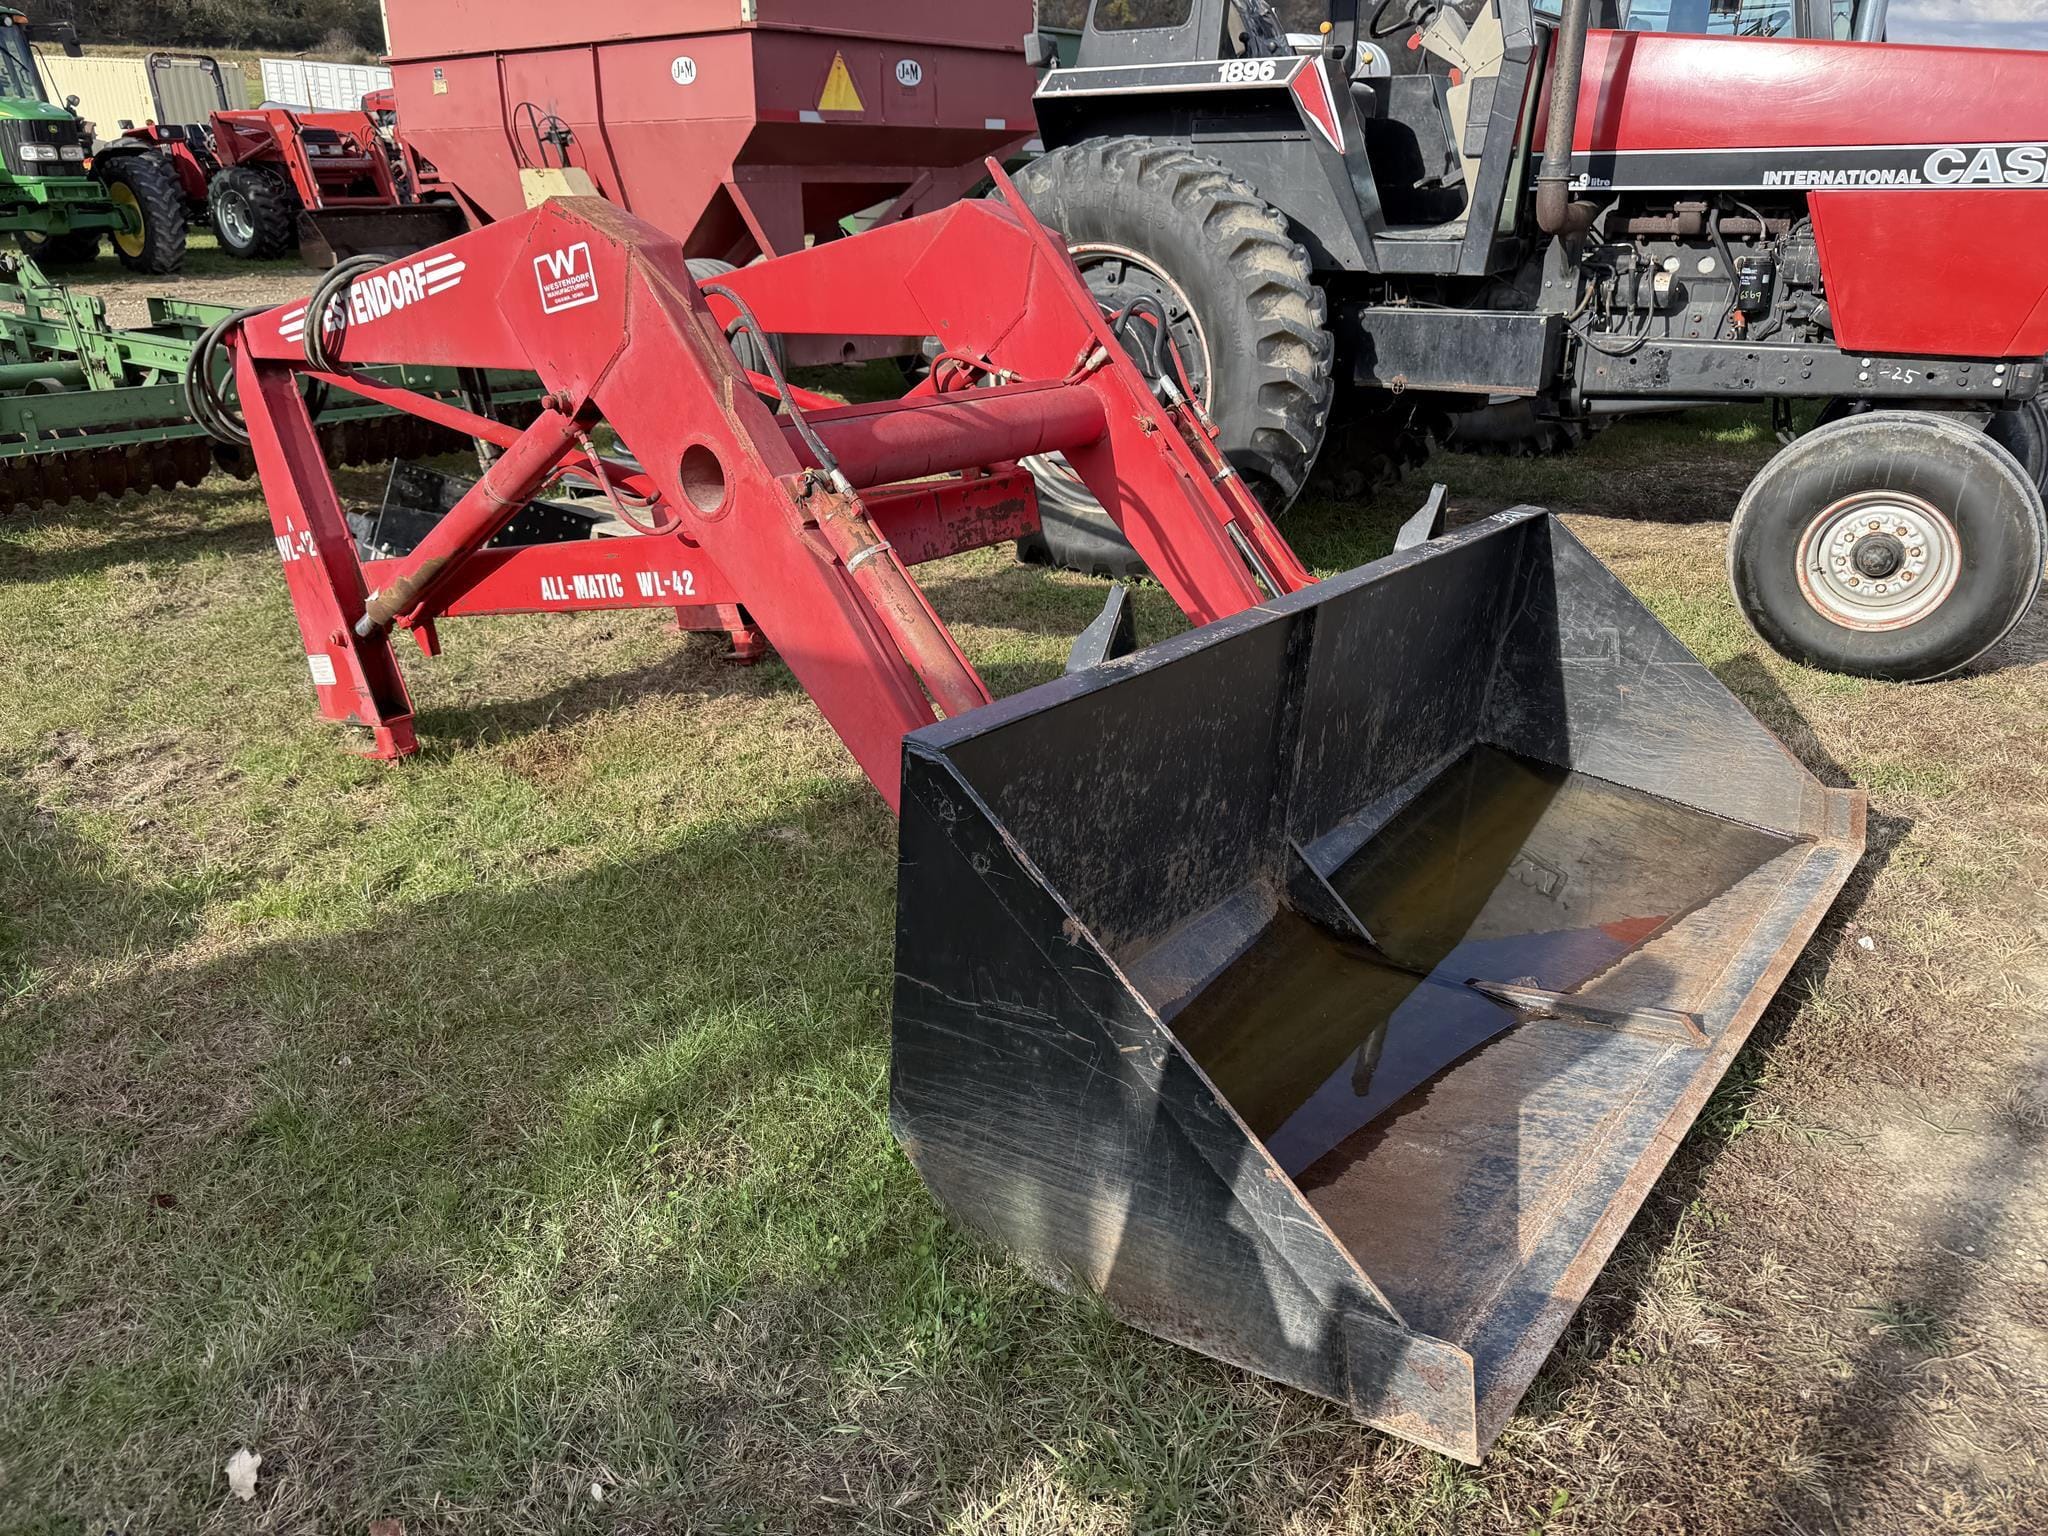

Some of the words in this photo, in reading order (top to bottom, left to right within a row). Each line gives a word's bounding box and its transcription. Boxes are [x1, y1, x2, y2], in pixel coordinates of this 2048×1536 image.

[898, 63, 919, 80] J&M
[1218, 60, 1277, 83] 1896
[1762, 169, 1922, 186] INTERNATIONAL
[1923, 146, 2048, 184] CAS
[543, 272, 591, 292] WESTENDORF
[547, 281, 590, 298] MANUFACTURING
[305, 261, 427, 333] ESTENDORF
[540, 573, 624, 601] ALL-MATIC
[635, 570, 696, 597] WL-42
